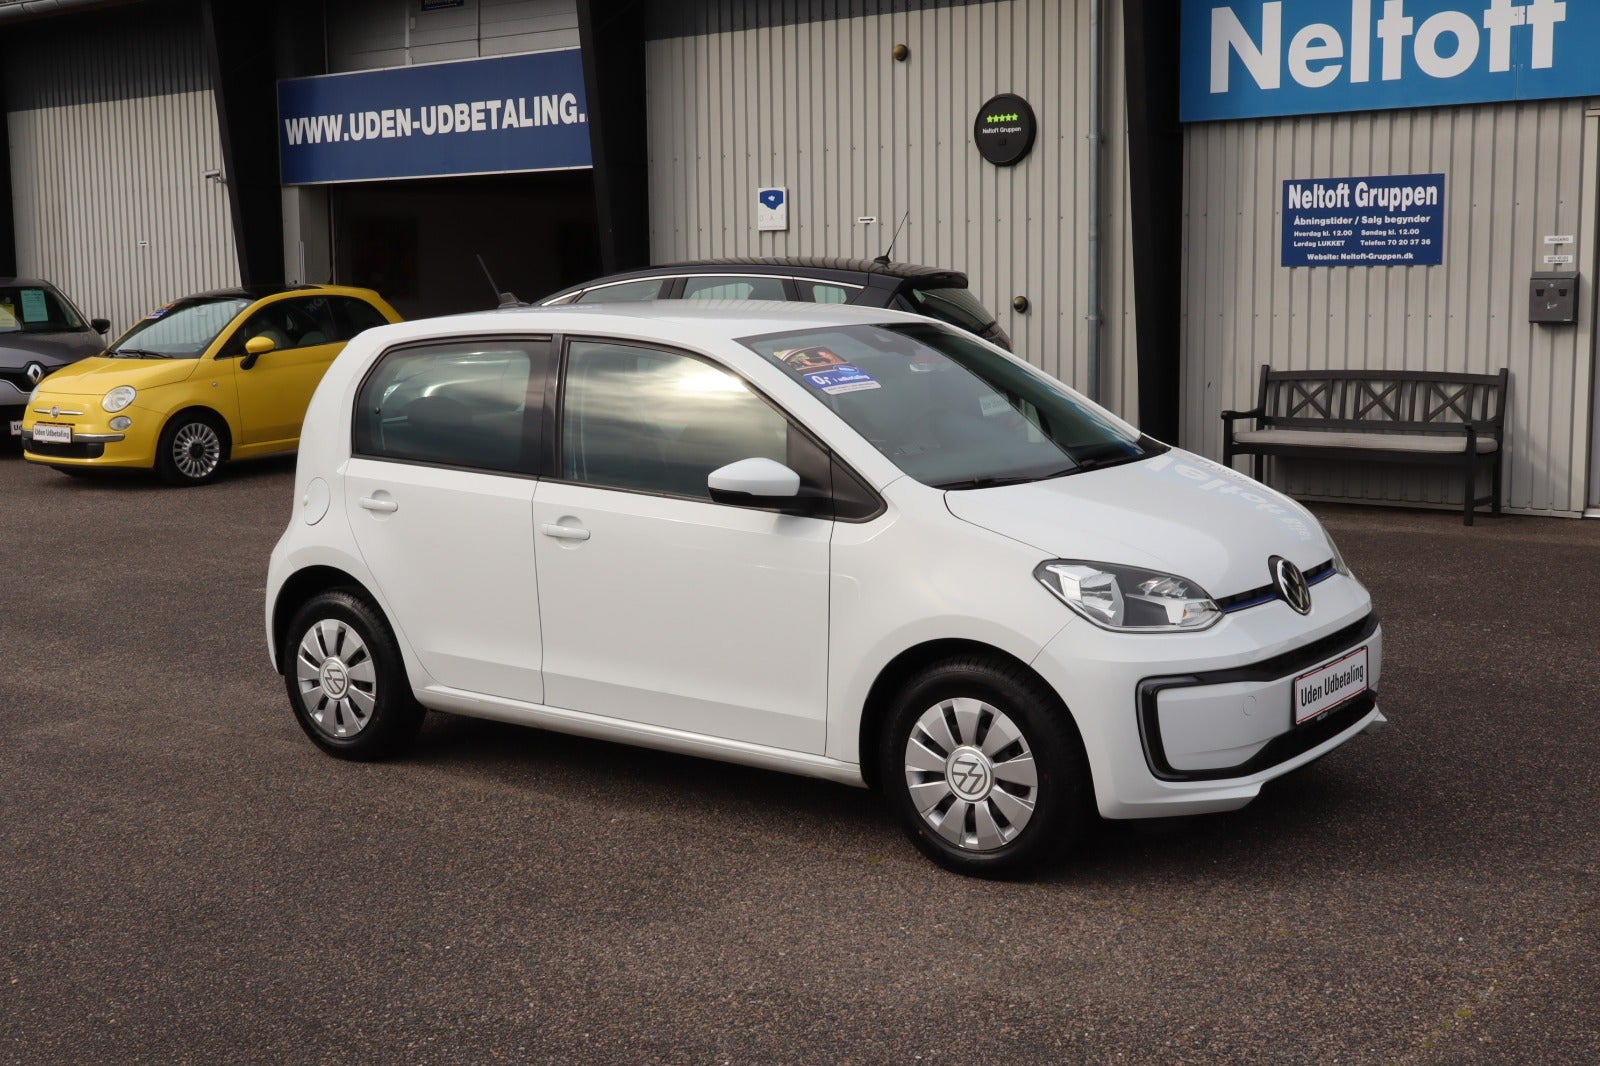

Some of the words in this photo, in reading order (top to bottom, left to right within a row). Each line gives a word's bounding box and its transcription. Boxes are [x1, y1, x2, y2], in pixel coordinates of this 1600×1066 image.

[1210, 0, 1566, 94] Neltoft
[285, 92, 589, 145] WWW.UDEN-UDBETALING.
[1288, 183, 1350, 209] Neltoft
[1354, 181, 1438, 212] Gruppen
[1294, 215, 1353, 226] Åbningstider
[1361, 215, 1382, 225] Salg
[1384, 214, 1431, 225] begynder
[1294, 230, 1321, 238] Hverdag
[1361, 229, 1387, 237] Søndag
[1340, 252, 1414, 261] Neltoft-Gruppen.dk
[35, 428, 45, 436] Uden
[46, 429, 69, 439] Udbetaling
[1300, 684, 1323, 707] Uden
[1324, 664, 1364, 696] Udbetaling
